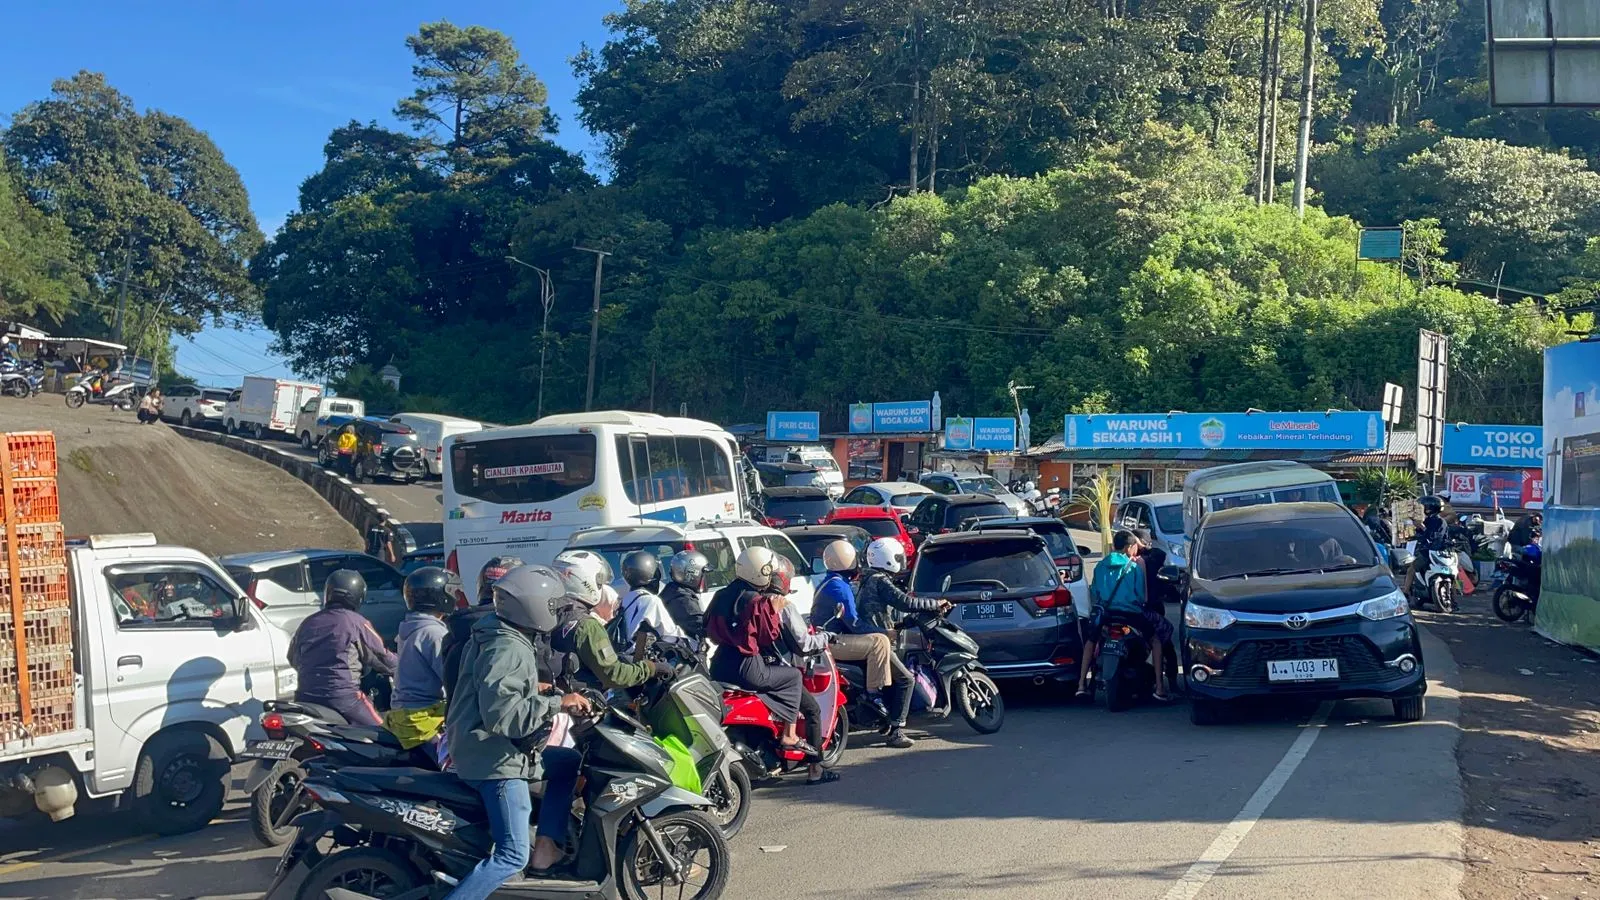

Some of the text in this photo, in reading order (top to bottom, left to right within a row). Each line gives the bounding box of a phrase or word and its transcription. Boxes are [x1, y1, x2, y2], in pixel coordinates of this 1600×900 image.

[876, 407, 929, 417] WARUNG KOPI
[778, 421, 816, 430] FIKRI CELL
[881, 416, 924, 425] BOGA RASA
[1106, 419, 1168, 431] WARUNG
[1092, 432, 1182, 443] SEKAR ASIH 1
[1308, 433, 1353, 442] Terlindungi
[1484, 431, 1535, 445] TOKO
[499, 508, 553, 524] Marita
[961, 603, 1013, 615] F 1580 NE
[1290, 660, 1315, 673] 1403
[1322, 660, 1336, 672] PK
